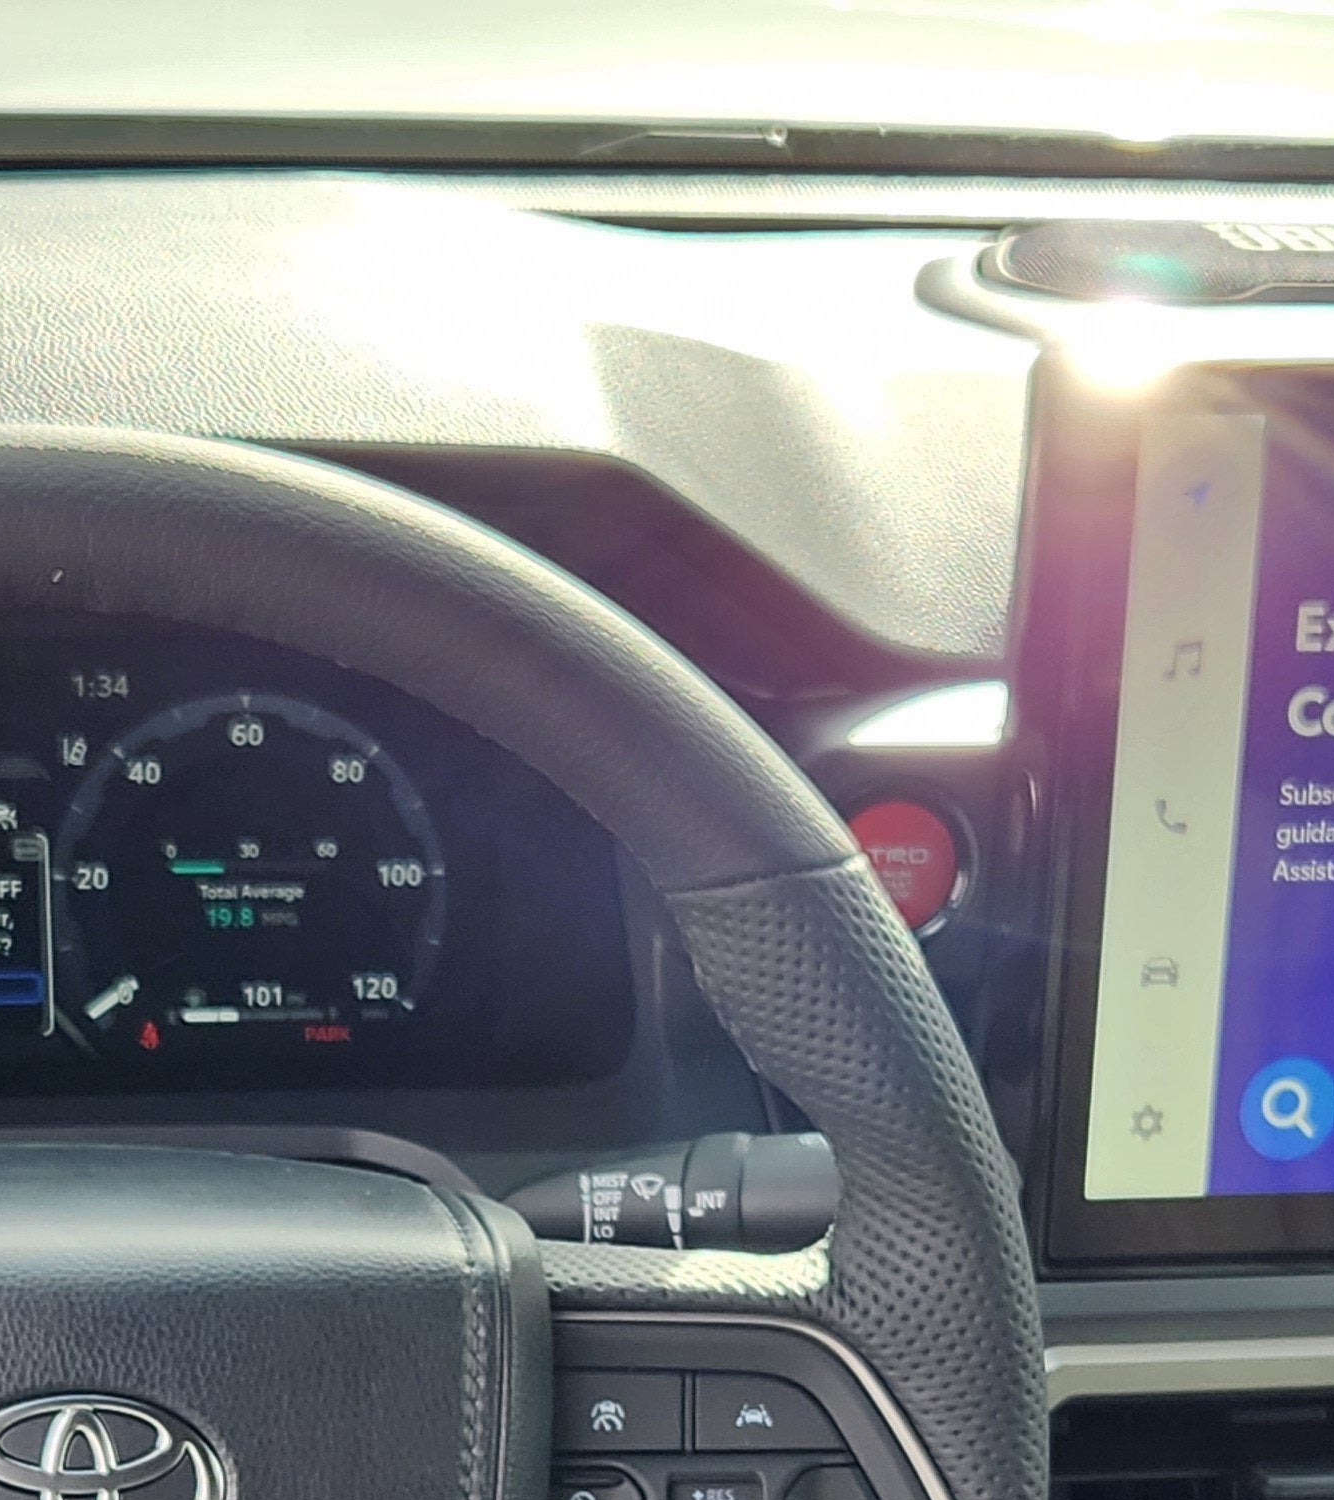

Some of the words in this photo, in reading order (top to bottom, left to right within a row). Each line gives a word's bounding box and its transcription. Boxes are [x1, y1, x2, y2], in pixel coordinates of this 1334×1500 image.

[73, 676, 129, 698] 1:34
[232, 725, 263, 747] 60
[129, 761, 161, 784] 40
[332, 760, 364, 783] 80
[238, 843, 260, 859] 30
[77, 869, 109, 891] 20
[378, 865, 422, 887] 100
[1273, 859, 1334, 882] Assist
[198, 884, 238, 900] Total
[241, 883, 305, 903] Average
[243, 986, 283, 1006] 101
[354, 977, 398, 999] 120
[592, 1172, 628, 1188] MIST
[593, 1191, 622, 1206] OFF
[695, 1190, 727, 1210] INT
[594, 1207, 620, 1221] INT
[594, 1224, 615, 1239] LO
